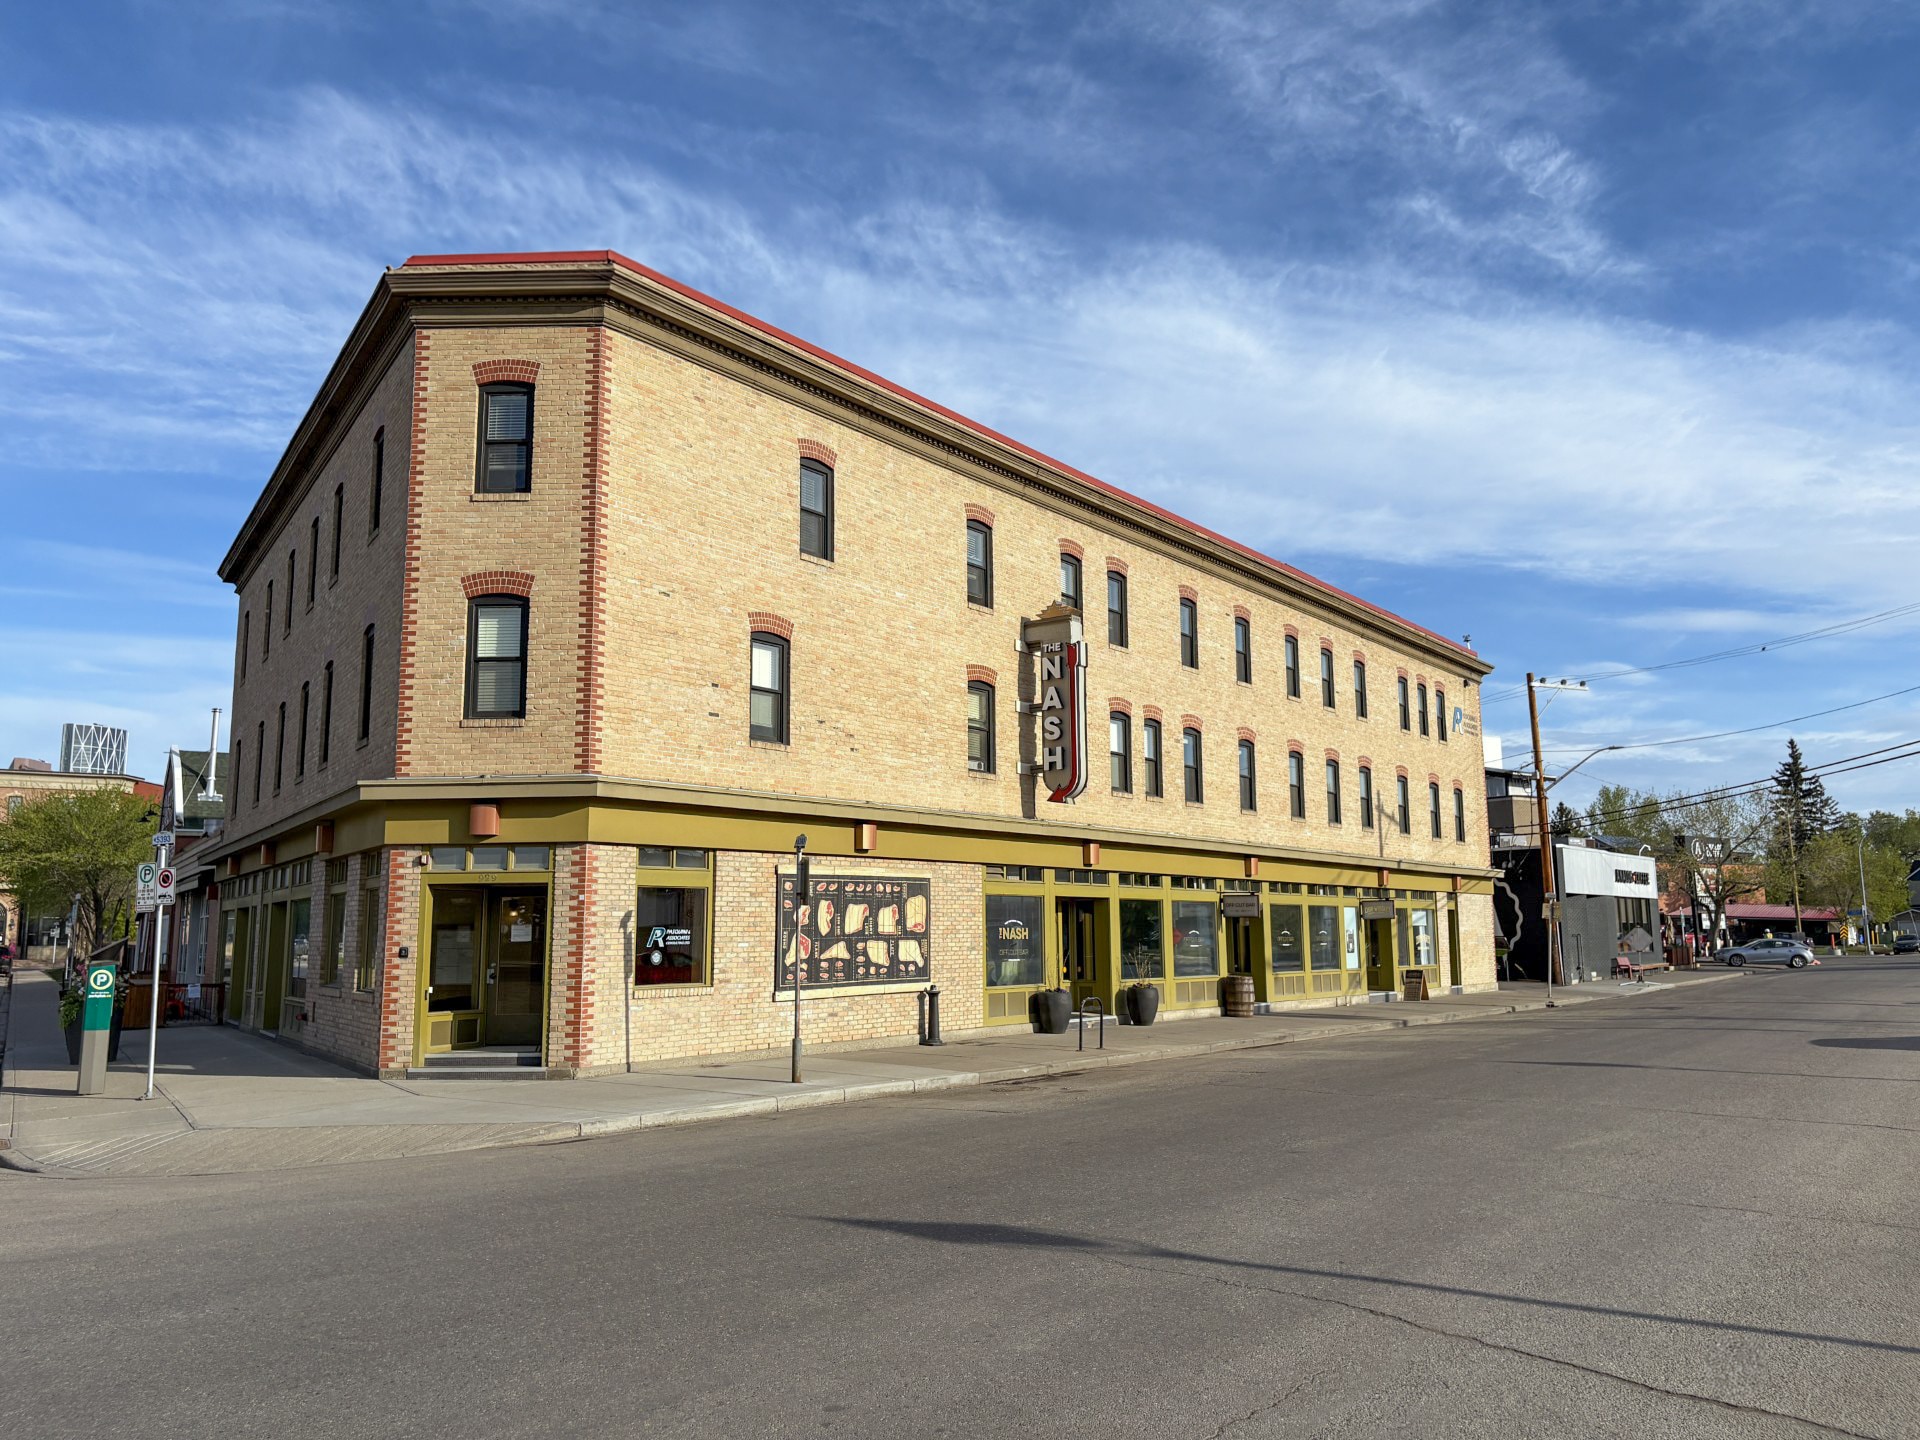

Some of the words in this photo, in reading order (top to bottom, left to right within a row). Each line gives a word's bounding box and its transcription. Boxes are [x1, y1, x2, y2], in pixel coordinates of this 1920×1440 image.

[1043, 642, 1062, 652] THE
[1042, 655, 1063, 771] NASH
[1003, 927, 1029, 940] NASH
[97, 974, 108, 986] P
